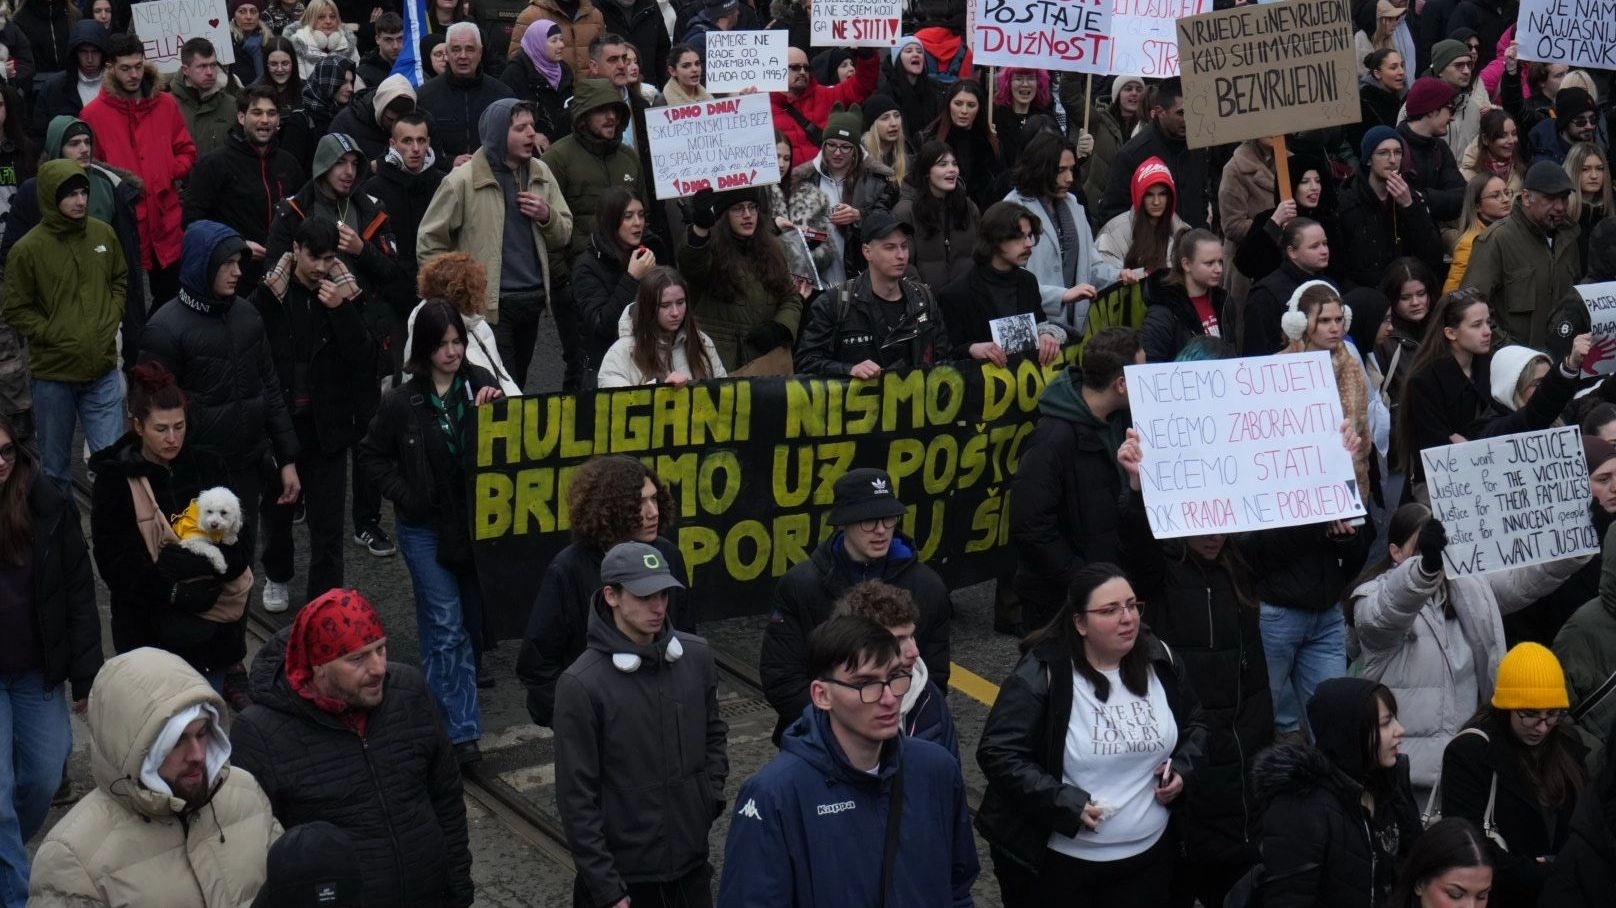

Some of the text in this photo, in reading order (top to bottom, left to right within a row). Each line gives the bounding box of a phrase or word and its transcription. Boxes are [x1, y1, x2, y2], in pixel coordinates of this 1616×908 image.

[813, 5, 821, 17] A
[825, 5, 838, 16] NE
[843, 5, 872, 16] SISTEM
[1546, 0, 1616, 21] JE NAM
[708, 34, 770, 47] KAMERE NE
[813, 16, 899, 45] GA NE ŠTITI!
[1181, 13, 1253, 47] VRIJEDE
[708, 48, 758, 58] RADE OD
[769, 56, 779, 65] A
[1192, 27, 1350, 74] KAD SU IM VRIJEDNI
[707, 68, 788, 82] VLADA OD 1995?
[1215, 60, 1339, 117] BEZVRIJEDNI
[707, 99, 741, 115] DNA!
[750, 112, 769, 127] BEZ
[653, 154, 666, 168] TO
[669, 150, 703, 167] SPADA
[706, 149, 716, 162] U
[1138, 366, 1226, 403] NEĆEMO
[477, 380, 752, 467] HULIGANI
[1135, 412, 1217, 449] NEĆEMO
[1139, 453, 1238, 492] NEĆEMO
[1424, 447, 1459, 473] We
[1470, 444, 1495, 468] want
[1431, 475, 1473, 500] Justice
[1481, 468, 1498, 492] for
[1503, 470, 1527, 489] THE
[1181, 498, 1238, 529] PRAVDA
[1242, 493, 1275, 524] NE
[1474, 495, 1490, 517] for
[1494, 488, 1531, 512] THEIR
[1446, 522, 1475, 545] ustice
[1479, 518, 1494, 539] for
[1502, 506, 1555, 534] INNOCENT
[1443, 544, 1487, 576] WE
[1496, 531, 1544, 566] WANT
[1091, 740, 1165, 755] THE MOON
[1093, 725, 1161, 742] LOVE BY
[817, 800, 856, 815] Kappa
